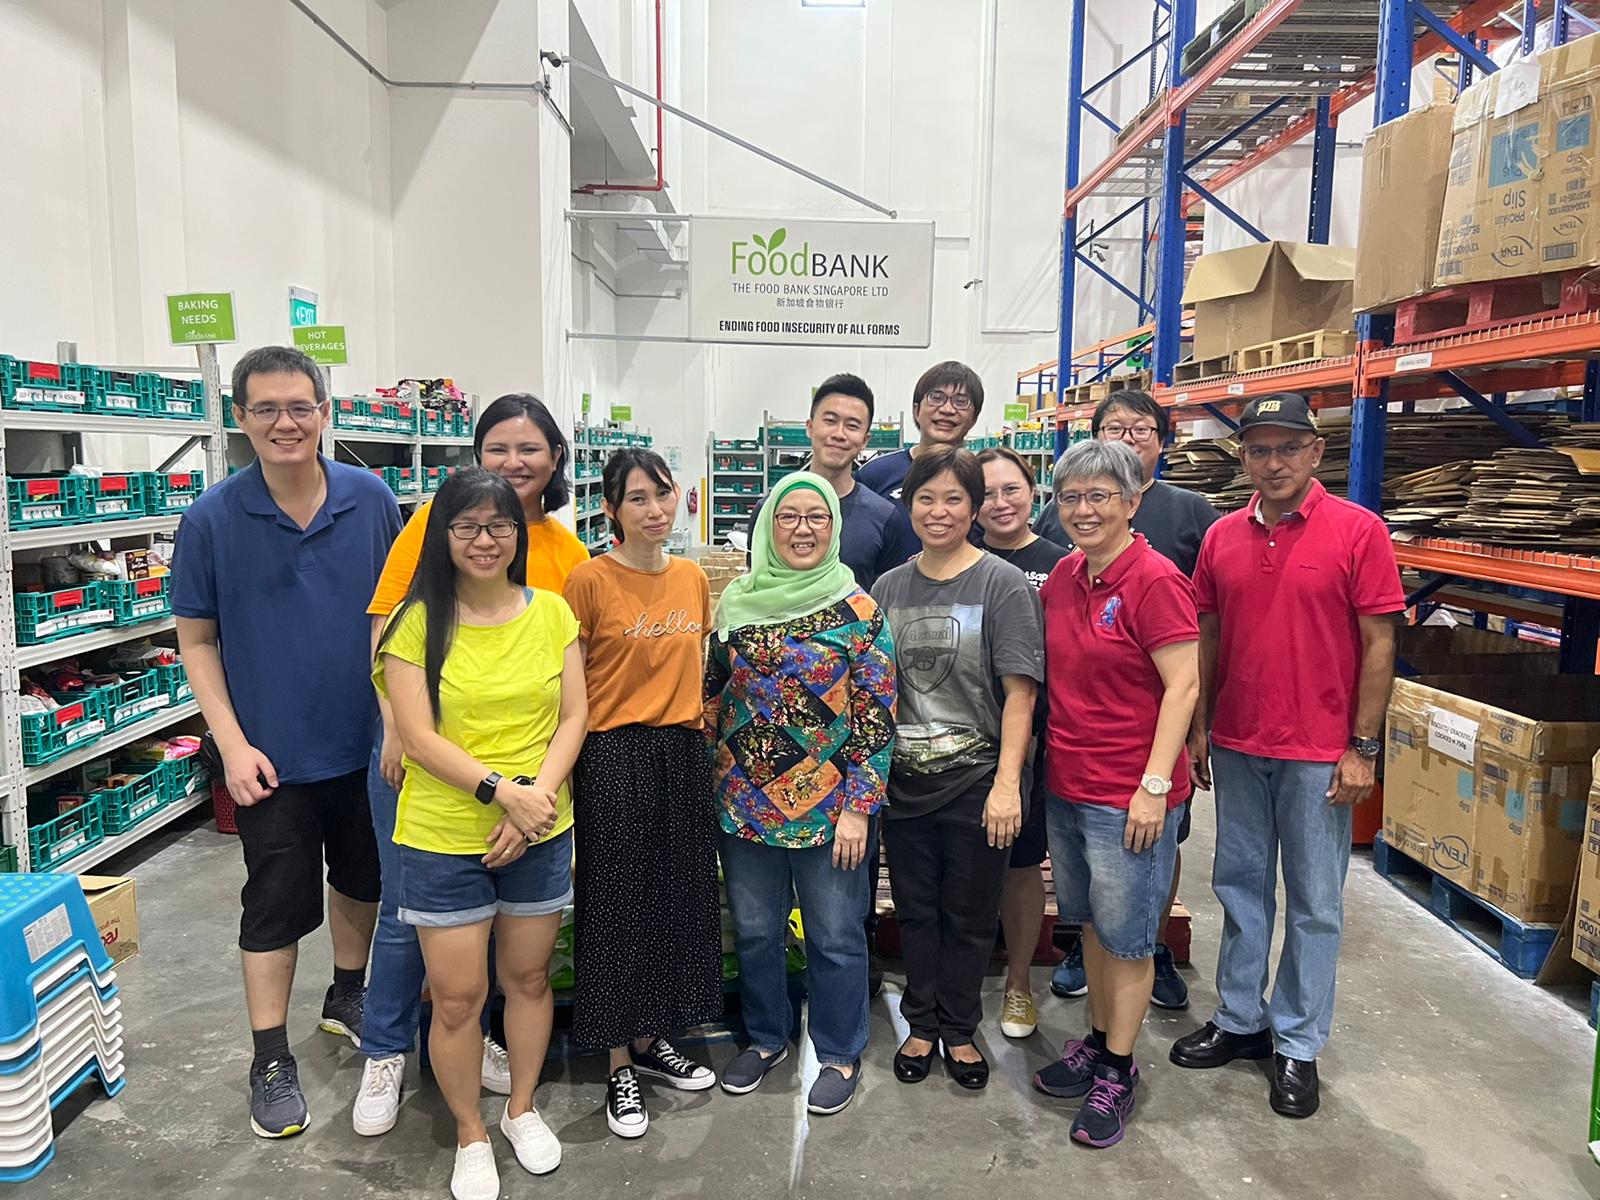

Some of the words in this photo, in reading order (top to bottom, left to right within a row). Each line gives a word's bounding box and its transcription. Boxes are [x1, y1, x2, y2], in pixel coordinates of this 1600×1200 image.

[1503, 188, 1526, 209] Slip
[1559, 221, 1576, 230] TENA
[1501, 245, 1524, 258] TENA
[732, 283, 750, 294] THE
[754, 283, 780, 295] FOOD
[784, 284, 810, 295] BANK
[813, 285, 868, 297] SINGAPORE
[871, 286, 889, 297] LTD
[1566, 284, 1582, 301] 20
[177, 299, 219, 311] BAKING
[776, 298, 844, 309] 新加坡食物银行
[181, 314, 217, 325] NEEDS
[300, 306, 315, 325] EXIT
[719, 320, 754, 333] ENDING
[756, 321, 780, 333] FOOD
[782, 322, 836, 335] INSECURITY
[837, 323, 849, 335] OF
[850, 323, 866, 335] ALL
[867, 324, 900, 336] FORMS
[307, 331, 327, 340] HOT
[295, 342, 345, 351] BEVERAGES
[624, 609, 701, 639] hello
[1431, 836, 1469, 867] TENA
